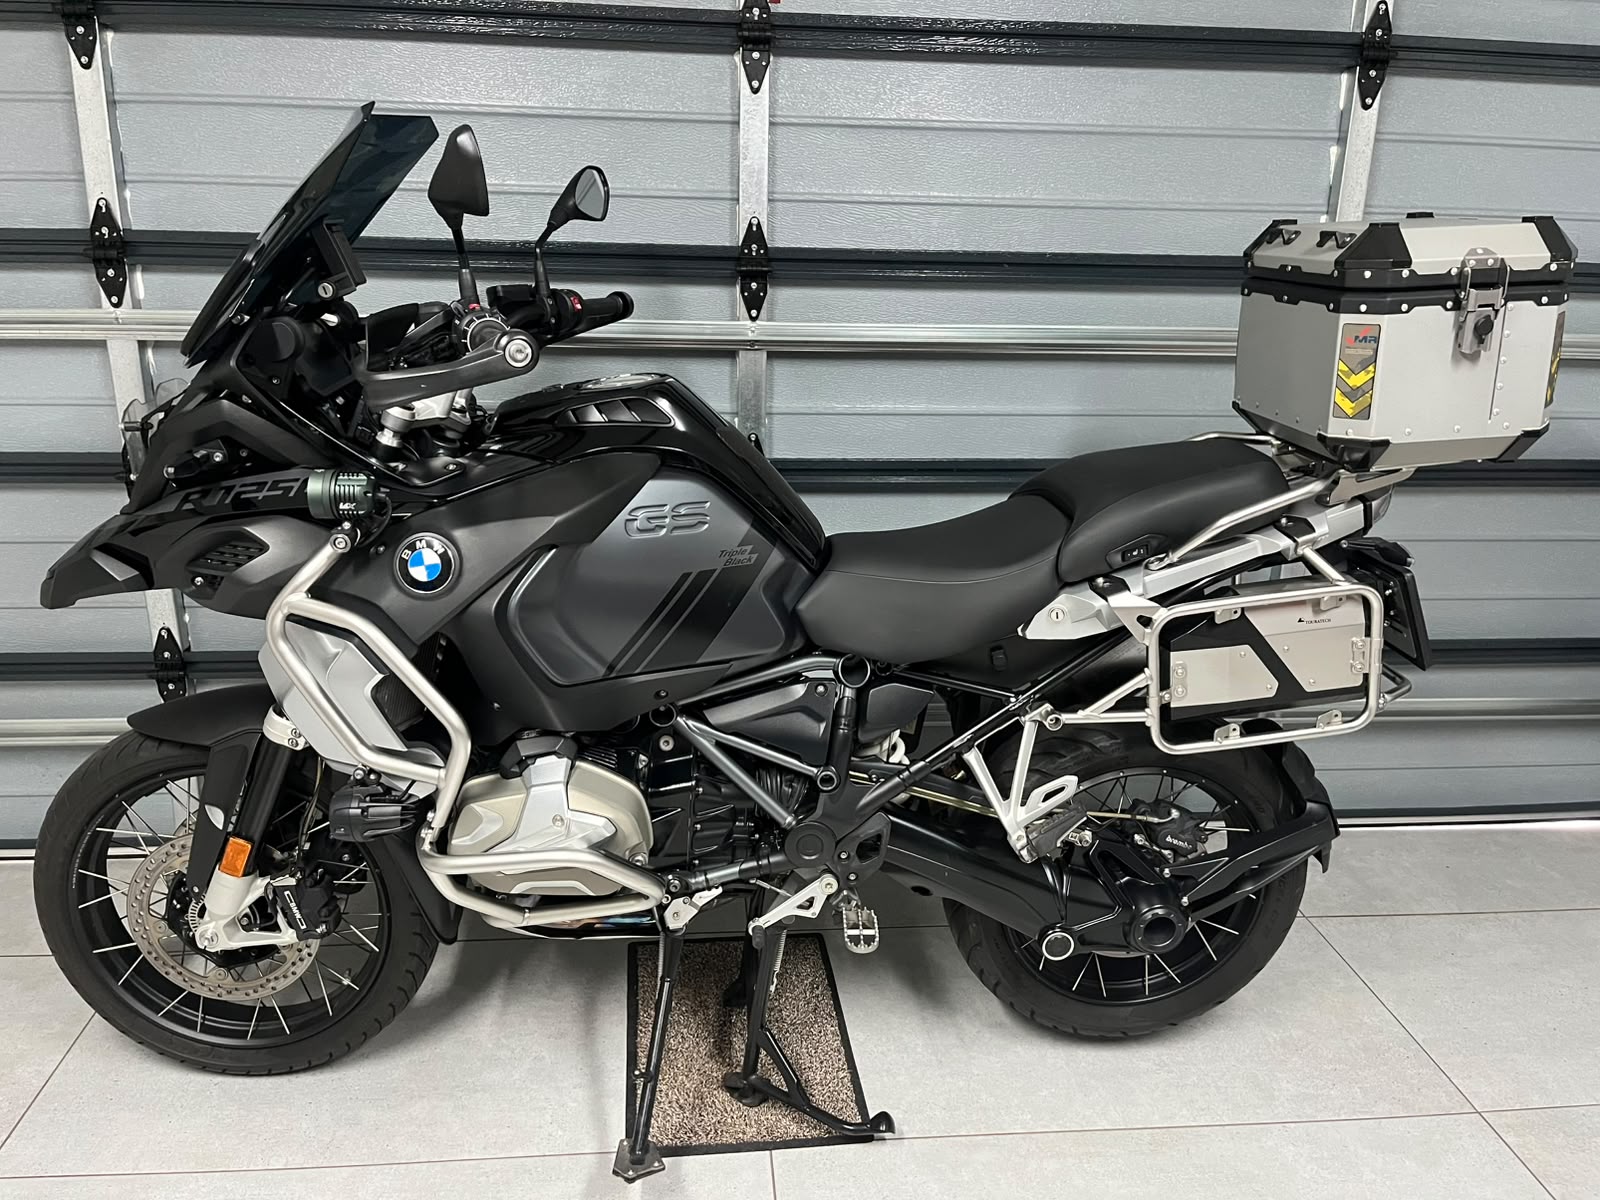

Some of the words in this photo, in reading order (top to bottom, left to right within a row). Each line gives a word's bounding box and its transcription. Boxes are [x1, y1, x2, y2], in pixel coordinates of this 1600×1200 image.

[624, 501, 711, 540] GS
[401, 539, 446, 560] BMW
[718, 547, 749, 559] Triple
[723, 554, 754, 567] Black
